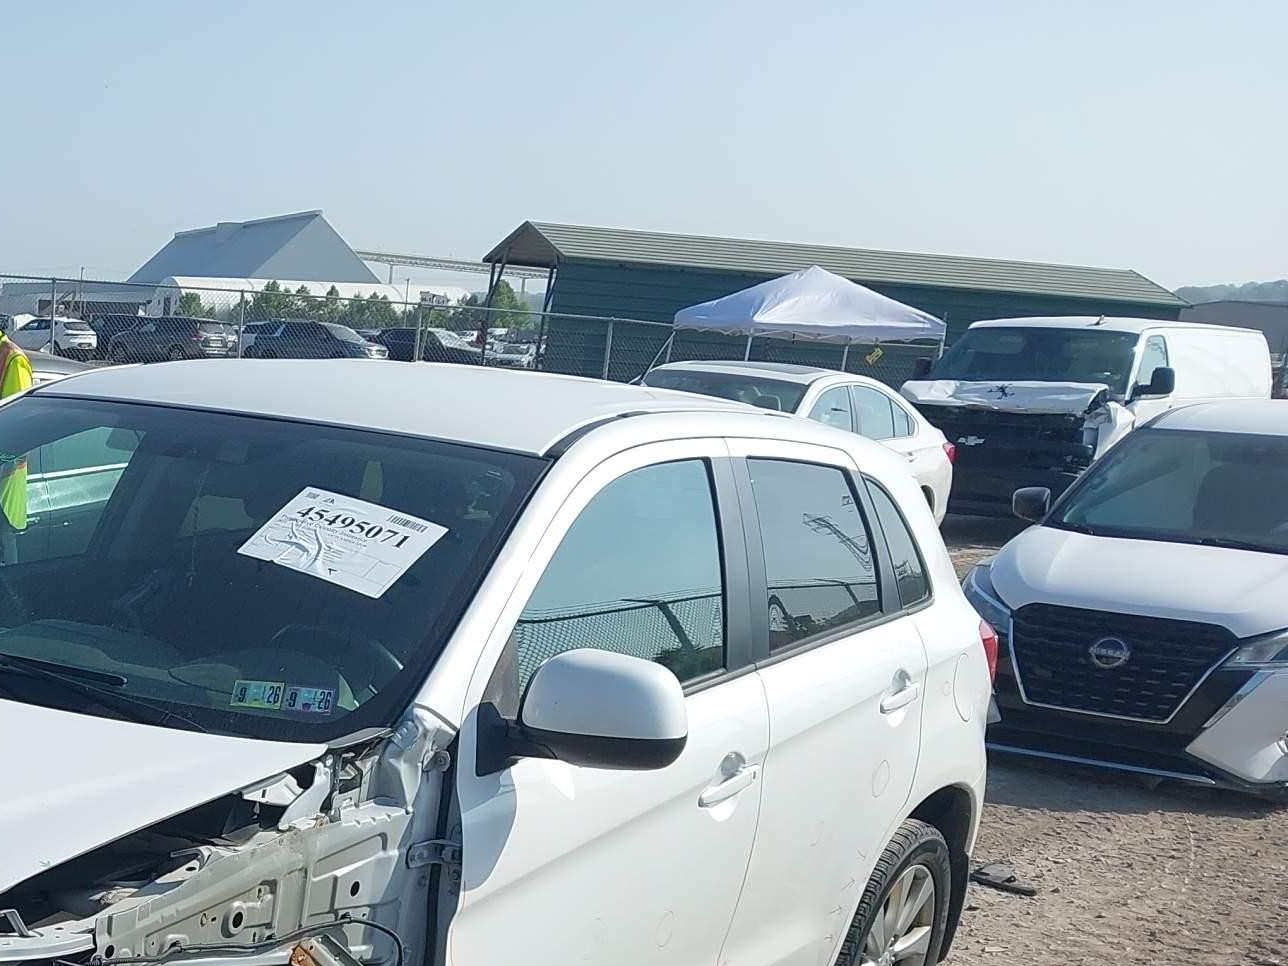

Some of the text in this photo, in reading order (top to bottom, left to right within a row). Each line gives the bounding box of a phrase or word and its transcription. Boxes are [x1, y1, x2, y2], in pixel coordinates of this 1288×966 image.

[296, 505, 412, 549] 45495071
[1089, 646, 1130, 659] NISSAN
[266, 686, 282, 705] 26
[317, 691, 332, 710] 26
